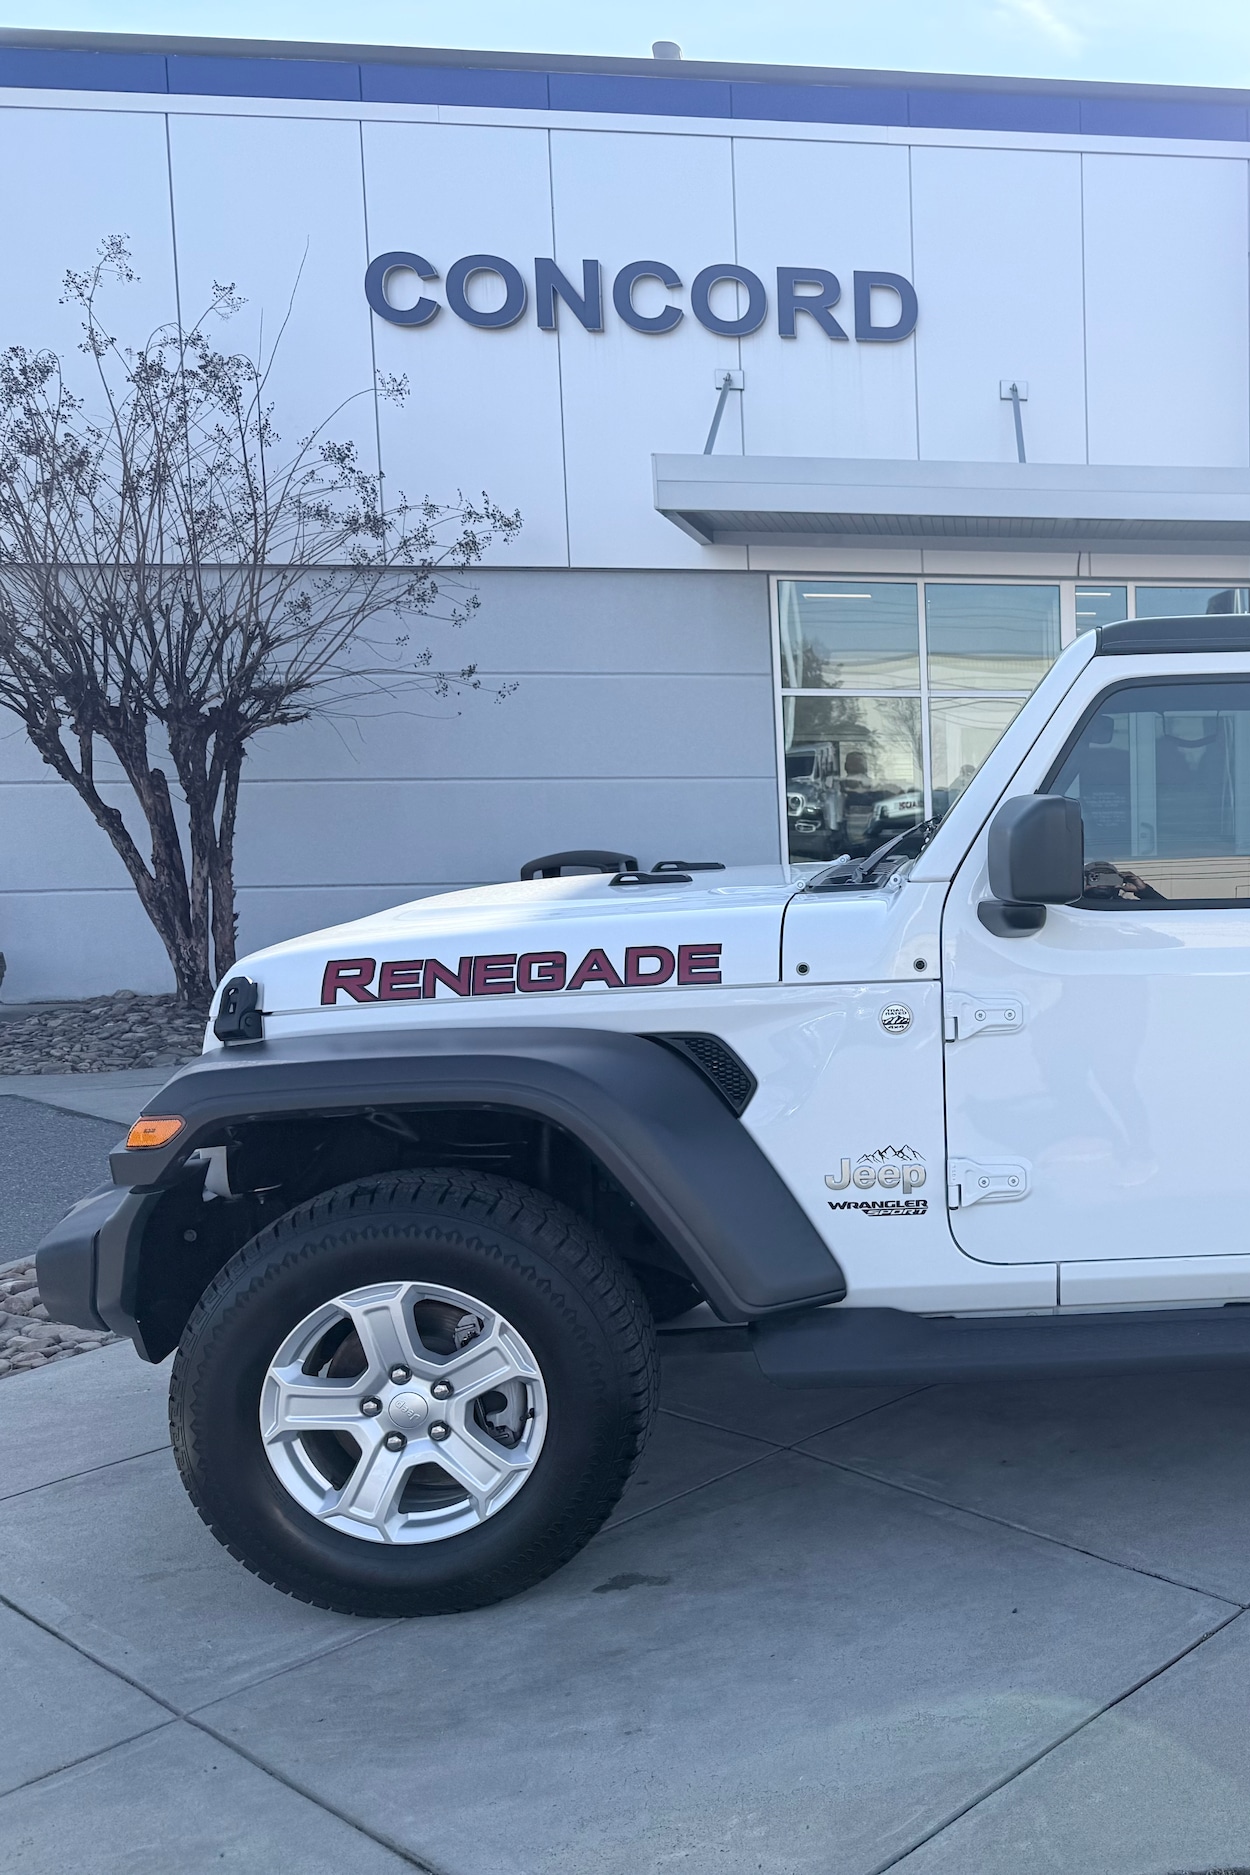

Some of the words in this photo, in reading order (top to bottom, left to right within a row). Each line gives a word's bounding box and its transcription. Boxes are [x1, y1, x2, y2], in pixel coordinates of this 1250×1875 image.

[364, 251, 919, 343] CONCORD
[321, 943, 722, 1005] RENEGADE
[824, 1158, 927, 1195] Jeep
[827, 1199, 929, 1210] WRANGLER
[395, 1400, 421, 1420] Jeep
